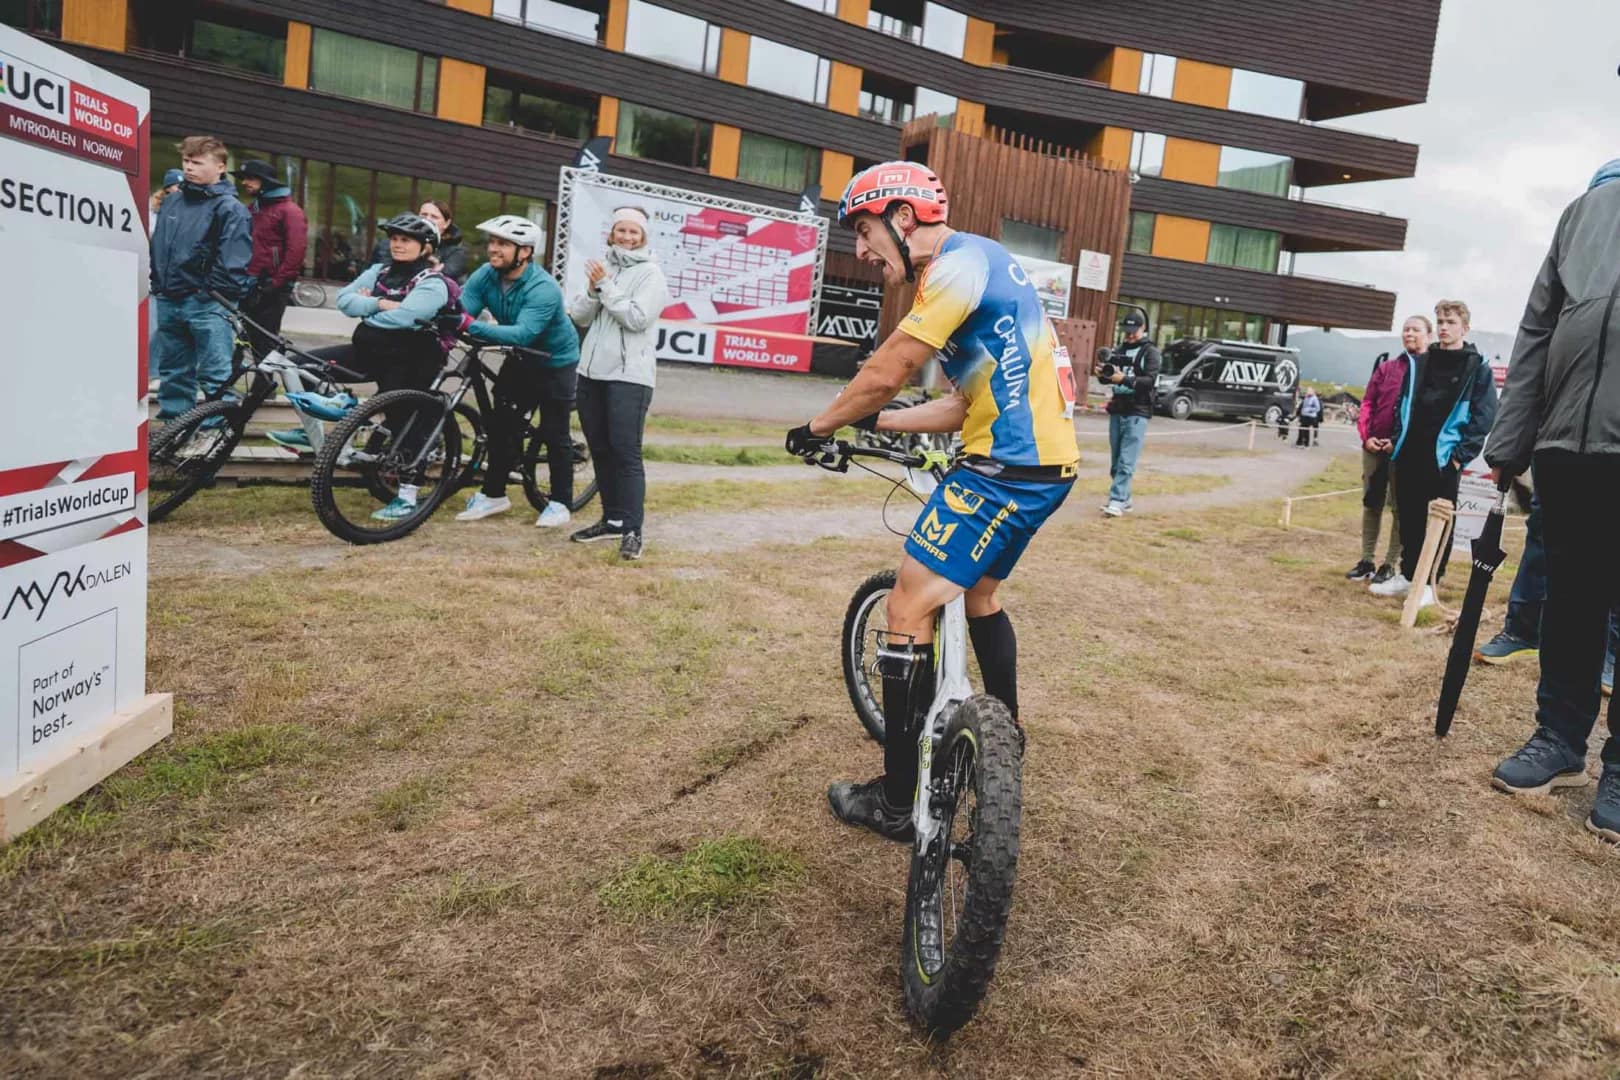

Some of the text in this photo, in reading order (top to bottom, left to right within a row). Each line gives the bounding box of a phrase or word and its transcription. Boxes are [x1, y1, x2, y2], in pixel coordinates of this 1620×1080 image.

[7, 64, 65, 115] UCI
[74, 91, 109, 115] TRIALS
[9, 114, 123, 161] MYRKDALEN NORWAY
[74, 107, 133, 139] WORLD CUP
[0, 178, 132, 233] SECTION 2
[851, 187, 935, 208] COMAS
[660, 212, 684, 225] UCI
[723, 349, 798, 366] WORLD CUP
[724, 335, 767, 350] TRIALS
[2, 485, 129, 529] #TrialsWorldCup
[911, 530, 949, 562] COMAS
[33, 661, 75, 695] Part of
